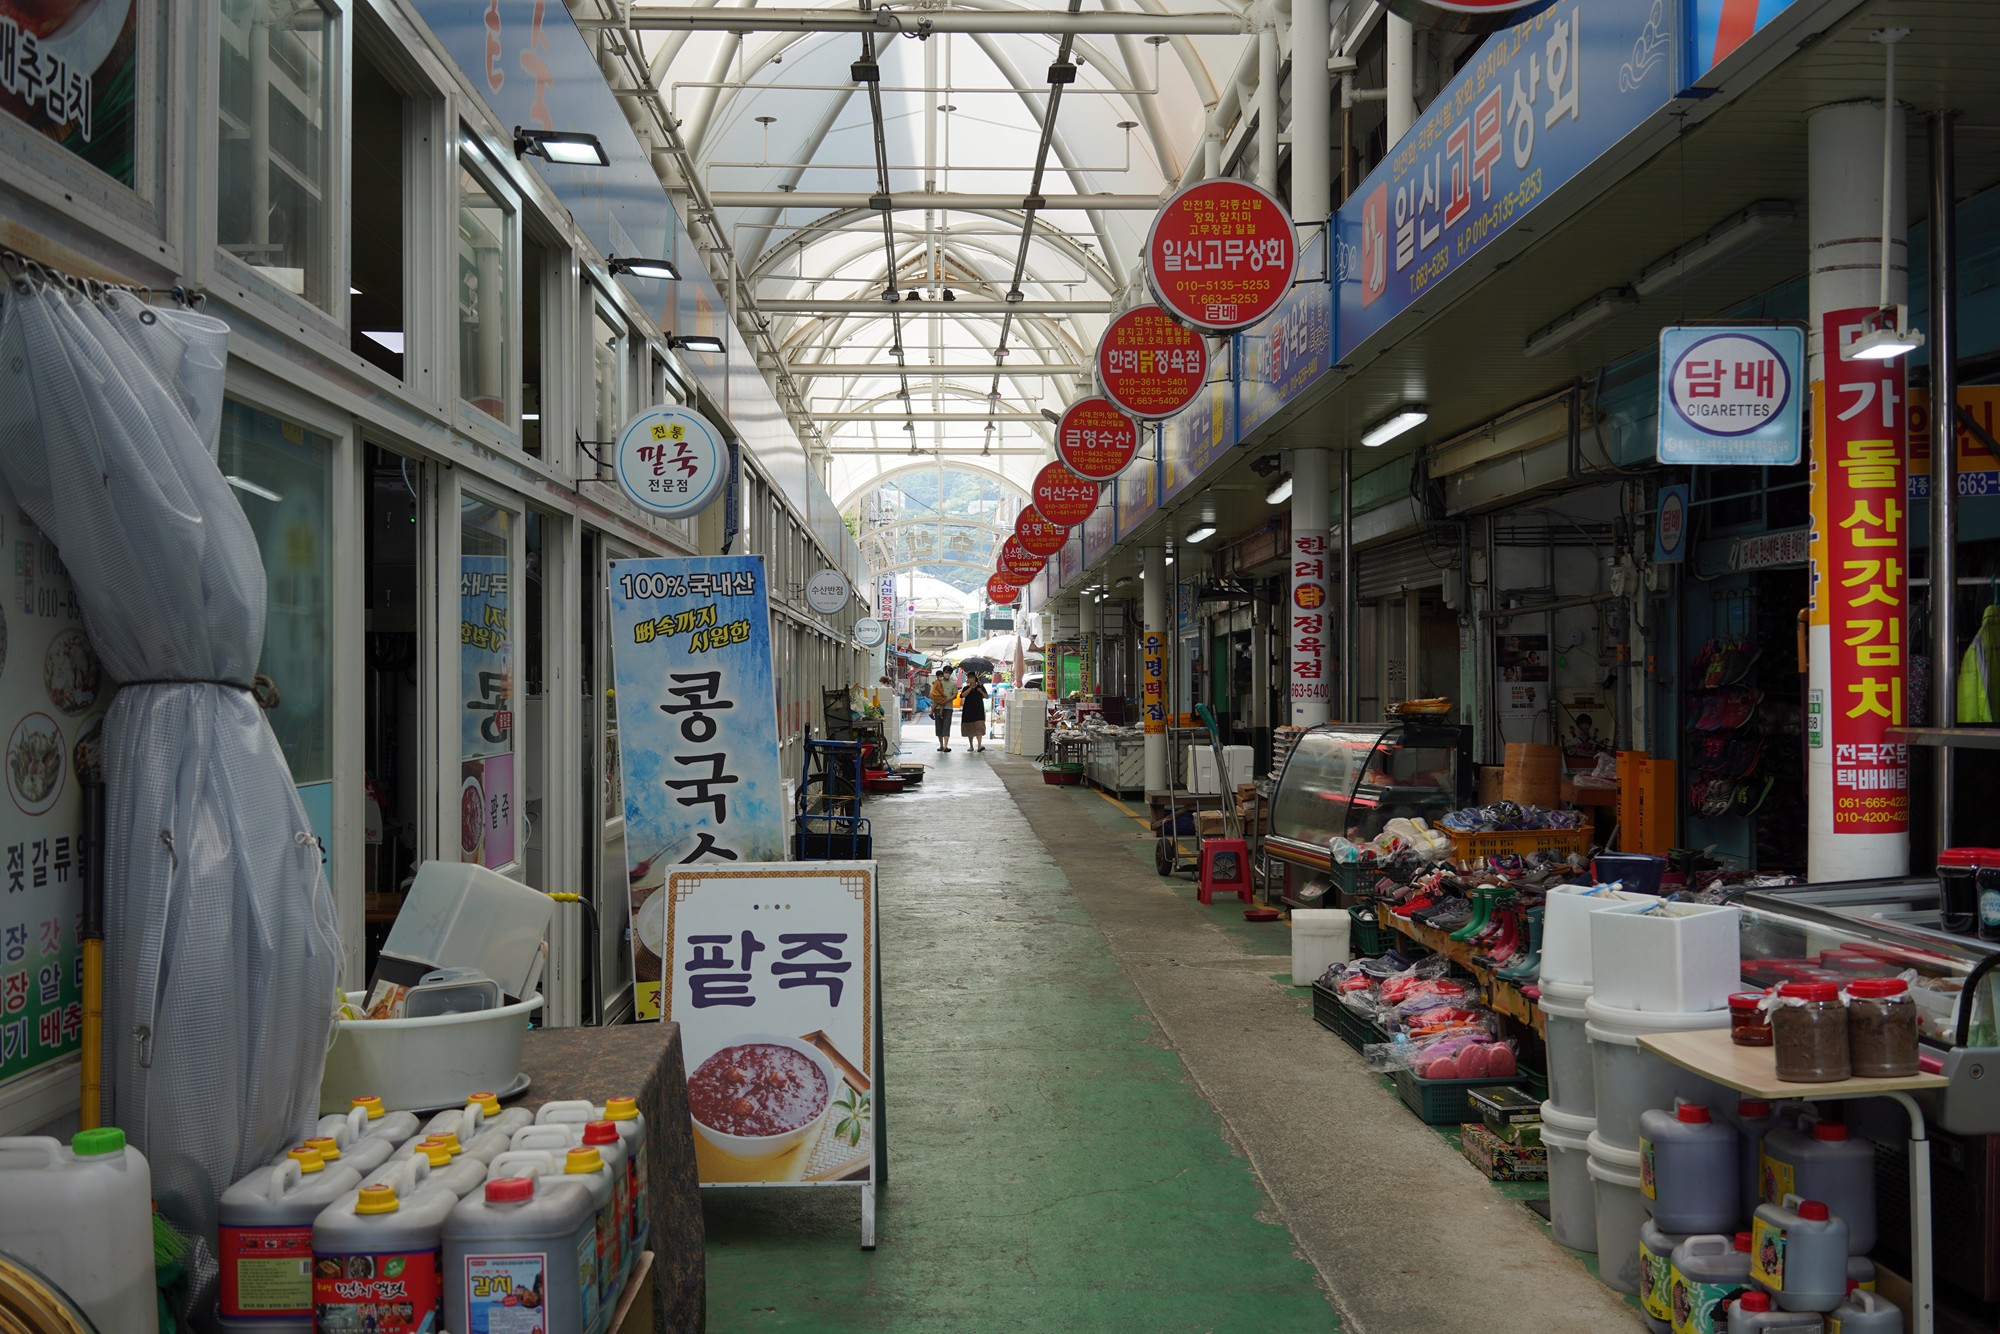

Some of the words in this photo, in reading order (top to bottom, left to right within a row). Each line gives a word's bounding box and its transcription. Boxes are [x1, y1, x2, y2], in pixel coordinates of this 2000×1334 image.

[1395, 5, 1580, 273] 일신고무상회
[1189, 224, 1231, 235] 고무장갑
[1409, 246, 1449, 295] T.663-5253
[1473, 167, 1543, 245] 010-5135-5253
[1163, 238, 1285, 272] 일신고무상회
[1176, 280, 1270, 291] 010-5135-5253
[1189, 294, 1258, 305] T.663-5253
[1206, 304, 1237, 320] 담배
[1108, 348, 1200, 374] 한려닭정육점
[1118, 378, 1187, 386] 010-3611-5401
[1685, 359, 1775, 399] 담배
[1119, 387, 1188, 395] 010-5256-5400
[1128, 397, 1180, 405] T.663-5400
[1687, 404, 1770, 417] CIGARETTES
[654, 425, 682, 439] 전통
[1066, 429, 1131, 449] 금영수산
[636, 442, 698, 478] 팥죽
[648, 479, 688, 492] 전문점
[1039, 486, 1094, 501] 여산수산
[1957, 472, 2000, 495] 663-
[621, 573, 686, 599] 100%
[689, 572, 754, 597] 국내산
[811, 585, 844, 596] 수산반점
[1838, 439, 1903, 725] 돌산갓김치
[1293, 535, 1328, 679] 한려닭정육점
[689, 620, 750, 653] 시원한
[1144, 635, 1164, 721] 유명떡집
[1836, 743, 1907, 765] 전국주문
[1837, 768, 1907, 790] 택배배달
[685, 930, 851, 1009] 팥죽
[471, 1275, 512, 1297] 갈치
